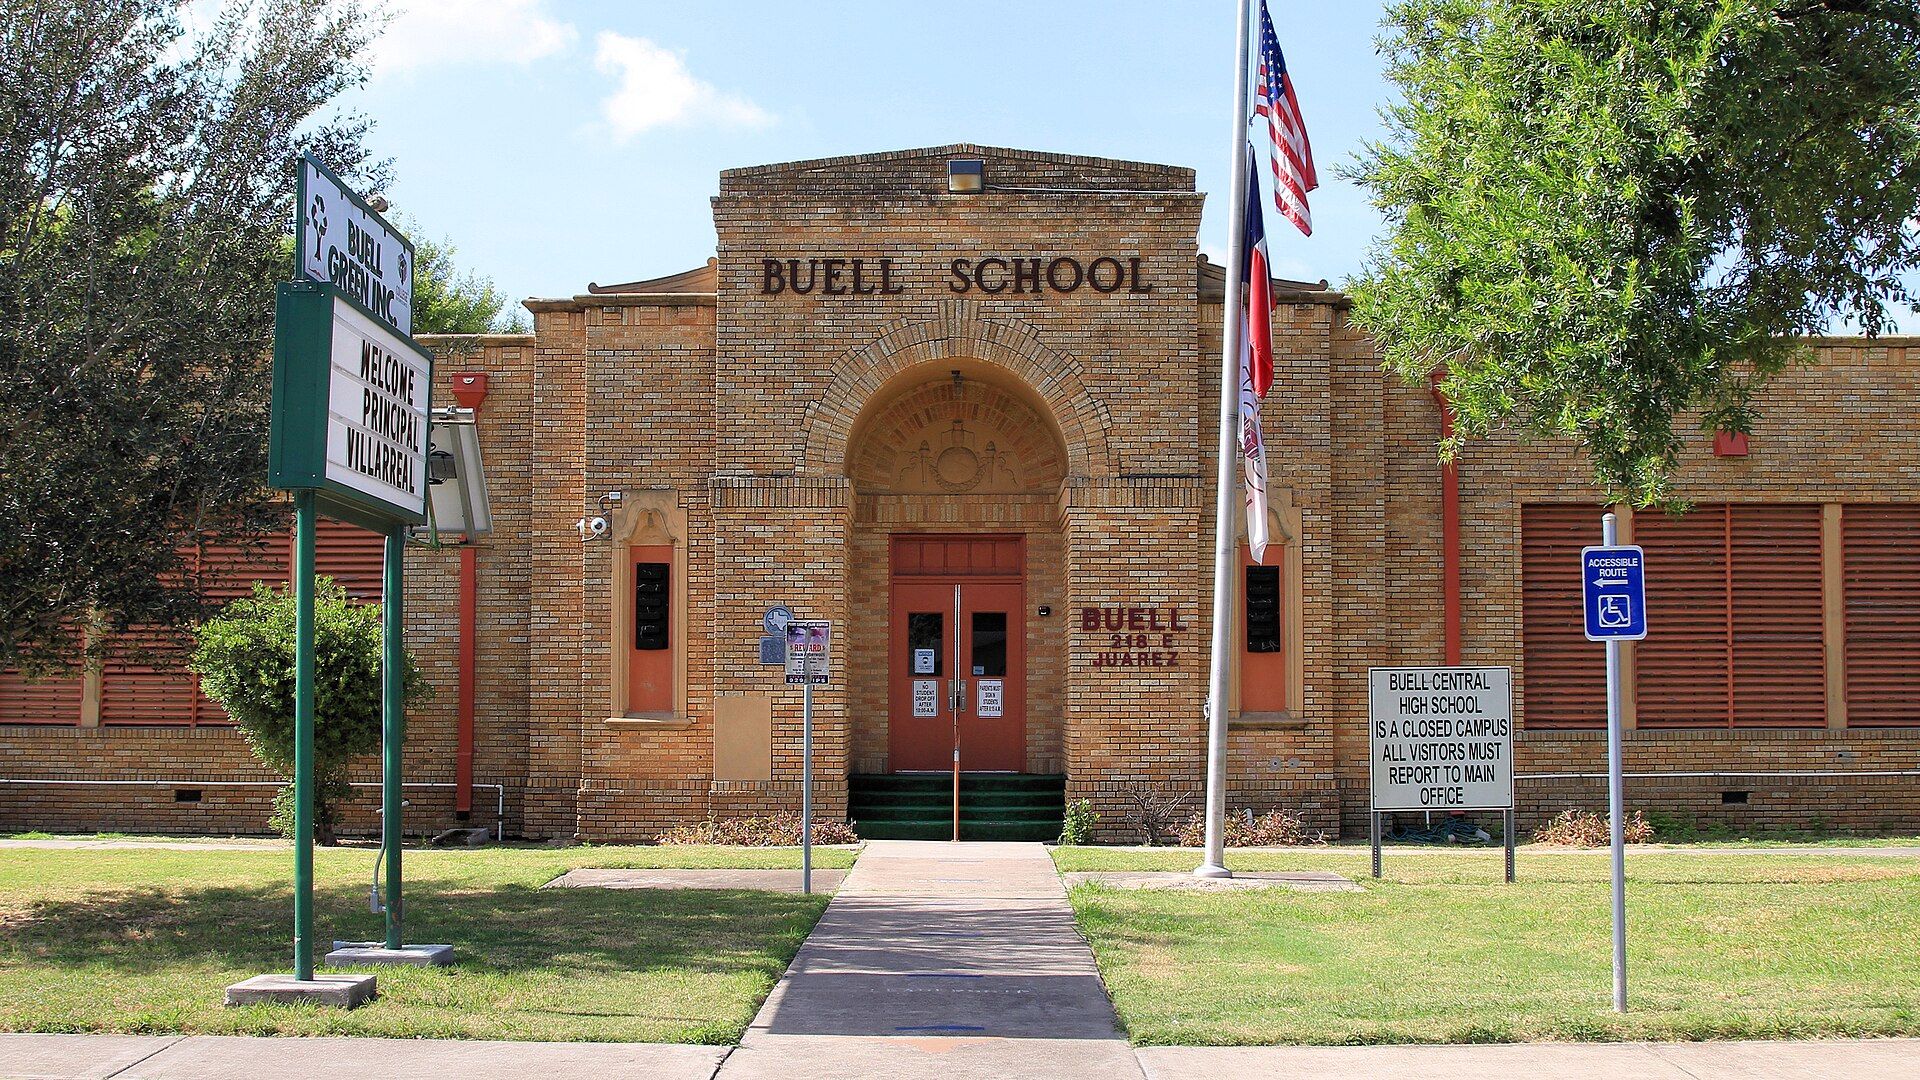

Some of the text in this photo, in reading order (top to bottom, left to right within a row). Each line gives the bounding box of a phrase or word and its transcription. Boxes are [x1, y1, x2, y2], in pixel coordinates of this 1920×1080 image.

[347, 218, 383, 279] BUELL
[761, 257, 1152, 295] BUELL SCHOOL
[328, 245, 370, 309] GREEN
[372, 281, 398, 328] INC.
[361, 339, 415, 407] WELCOME
[363, 391, 419, 453] PRINCIPAL
[347, 426, 415, 493] VILLARREAL
[1588, 558, 1638, 567] ACCESSIBLE
[1599, 568, 1628, 577] ROUTE
[1082, 607, 1187, 631] BUELL
[1112, 634, 1173, 648] 218 E
[1093, 652, 1178, 667] JUAREZ
[1390, 673, 1490, 691] BUELL CENTRAL
[1399, 696, 1482, 714] HIGH SCHOOL
[1376, 719, 1508, 738] IS A CLOSED CAMPUS
[1382, 742, 1502, 761] ALL VISITORS MUST
[1389, 765, 1495, 784] REPORT TO MAIN
[1420, 787, 1464, 805] OFFICE
